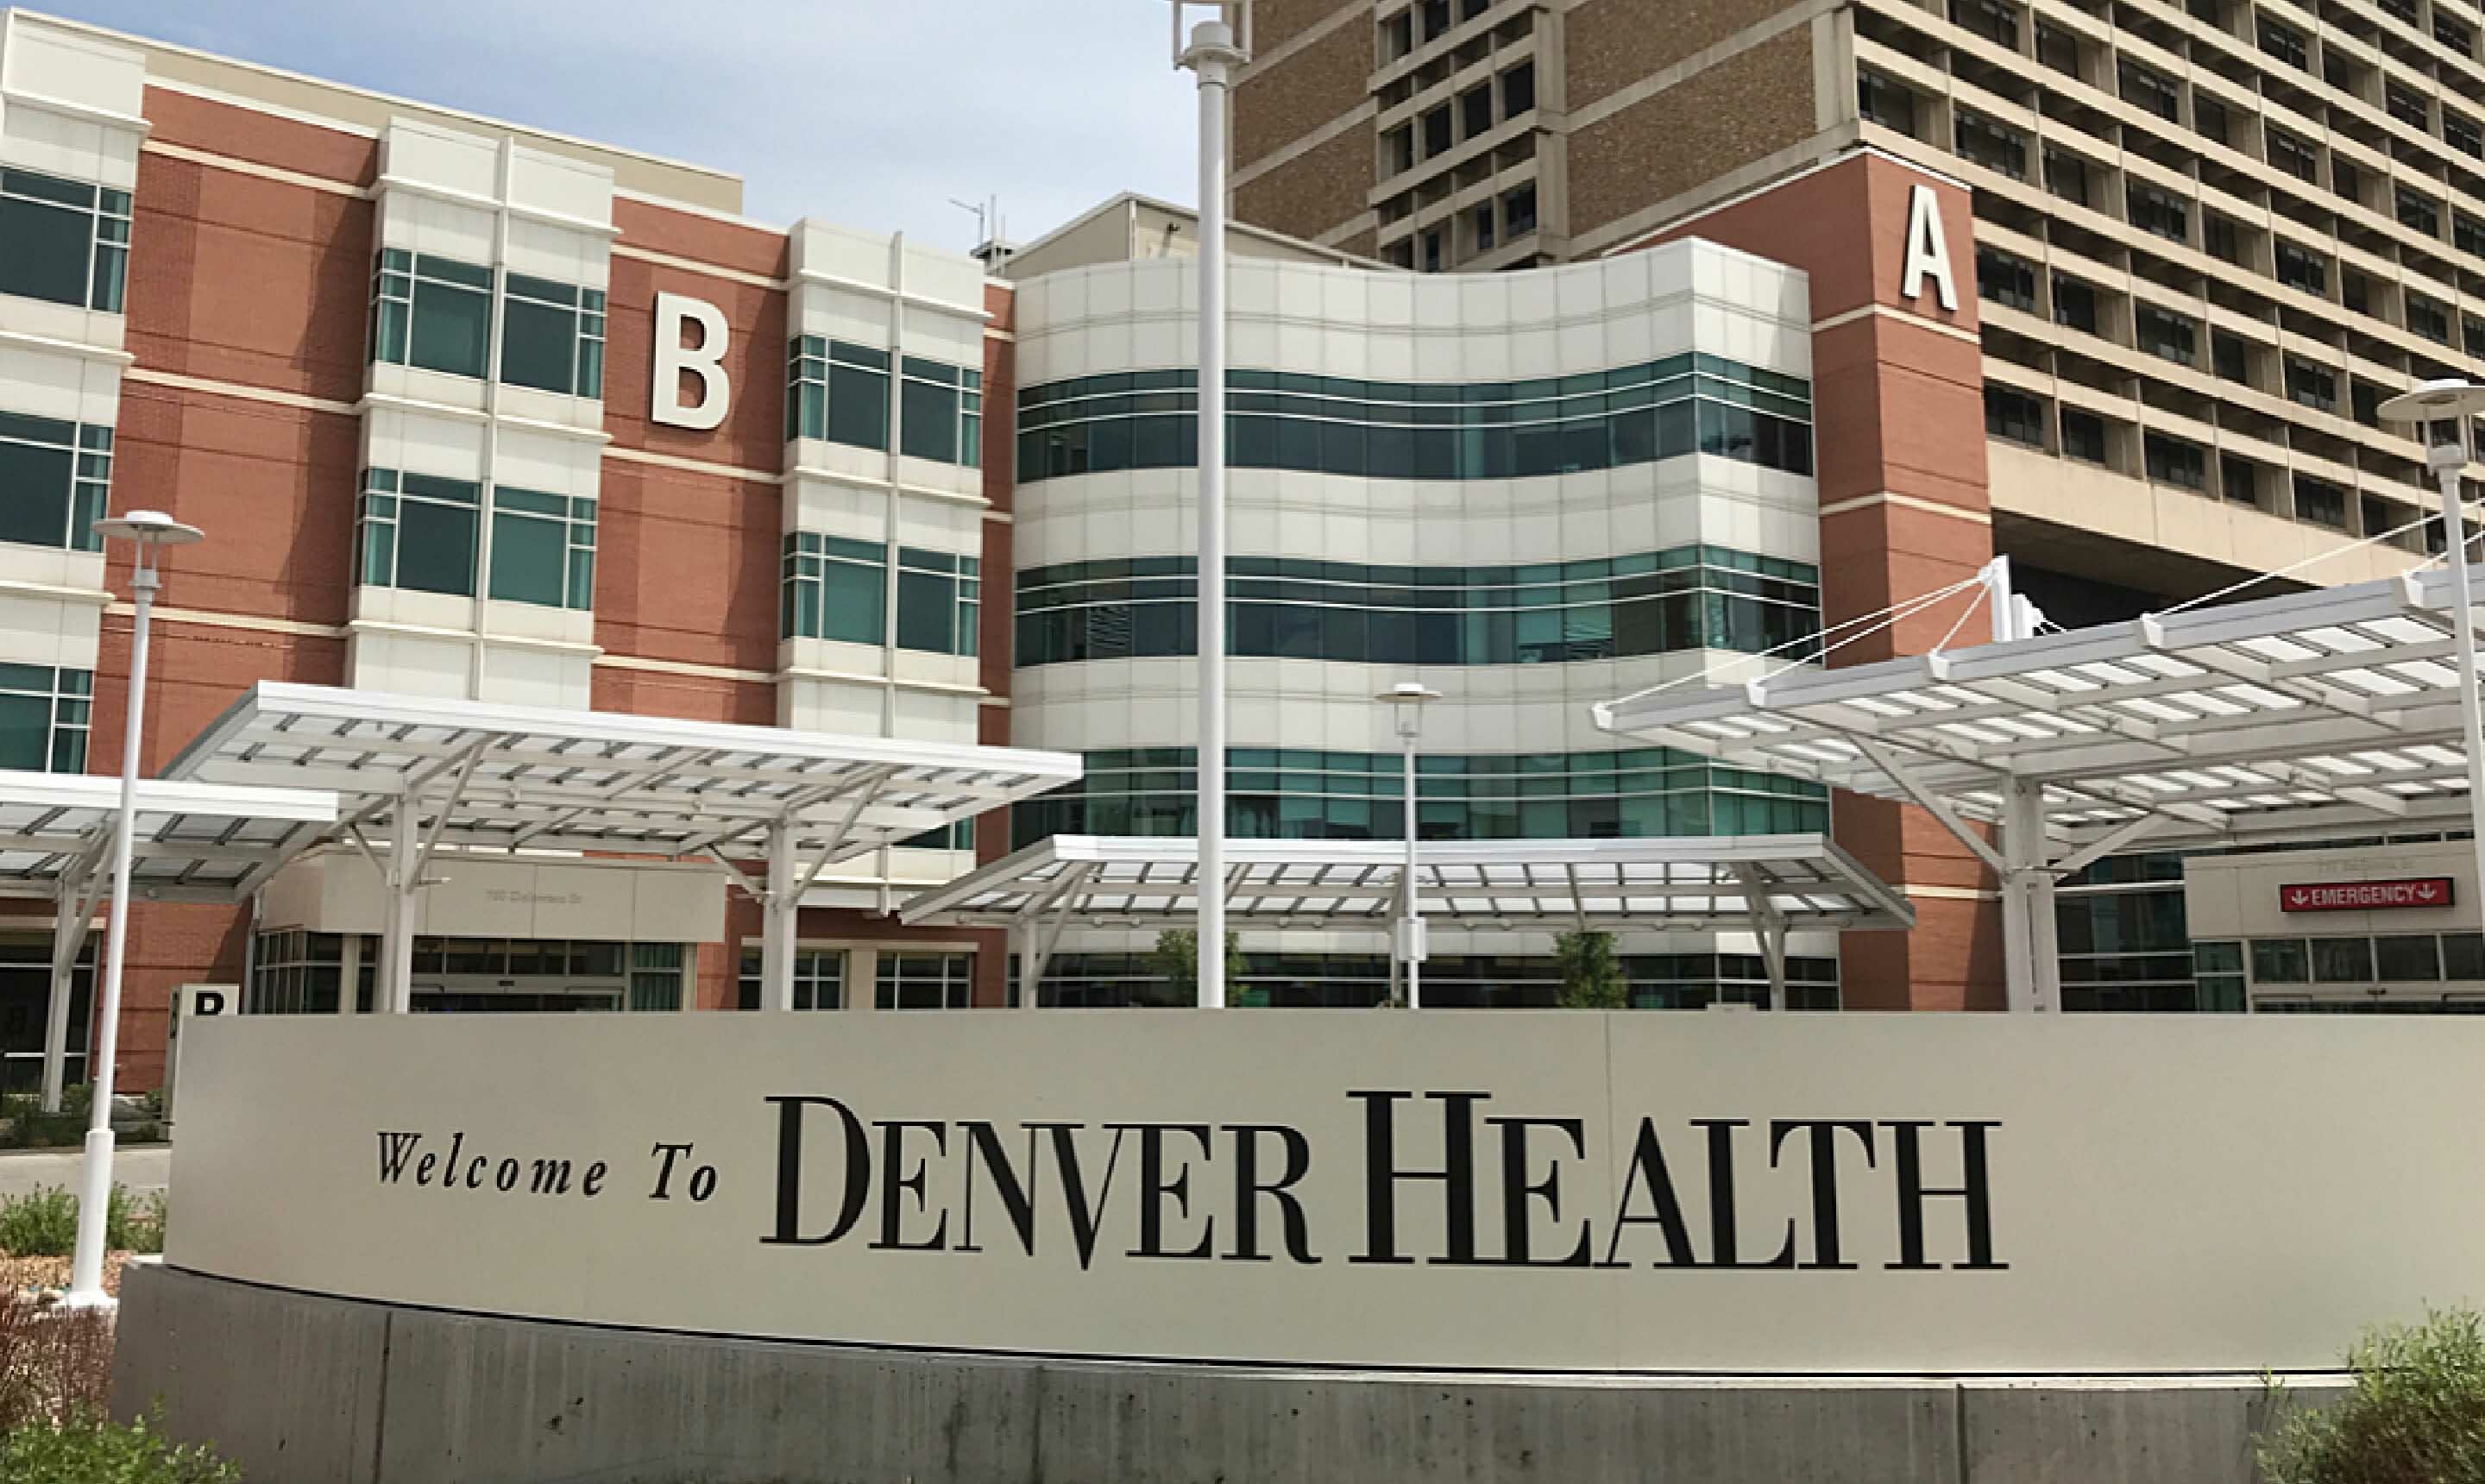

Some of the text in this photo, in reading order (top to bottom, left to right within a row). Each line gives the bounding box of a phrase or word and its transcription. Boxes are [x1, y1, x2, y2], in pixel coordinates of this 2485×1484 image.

[1904, 185, 1958, 311] A
[652, 291, 730, 430] B
[2312, 883, 2416, 906] EMERGENCY
[376, 1091, 2010, 1272] Welcome To DENVER HEALTH
